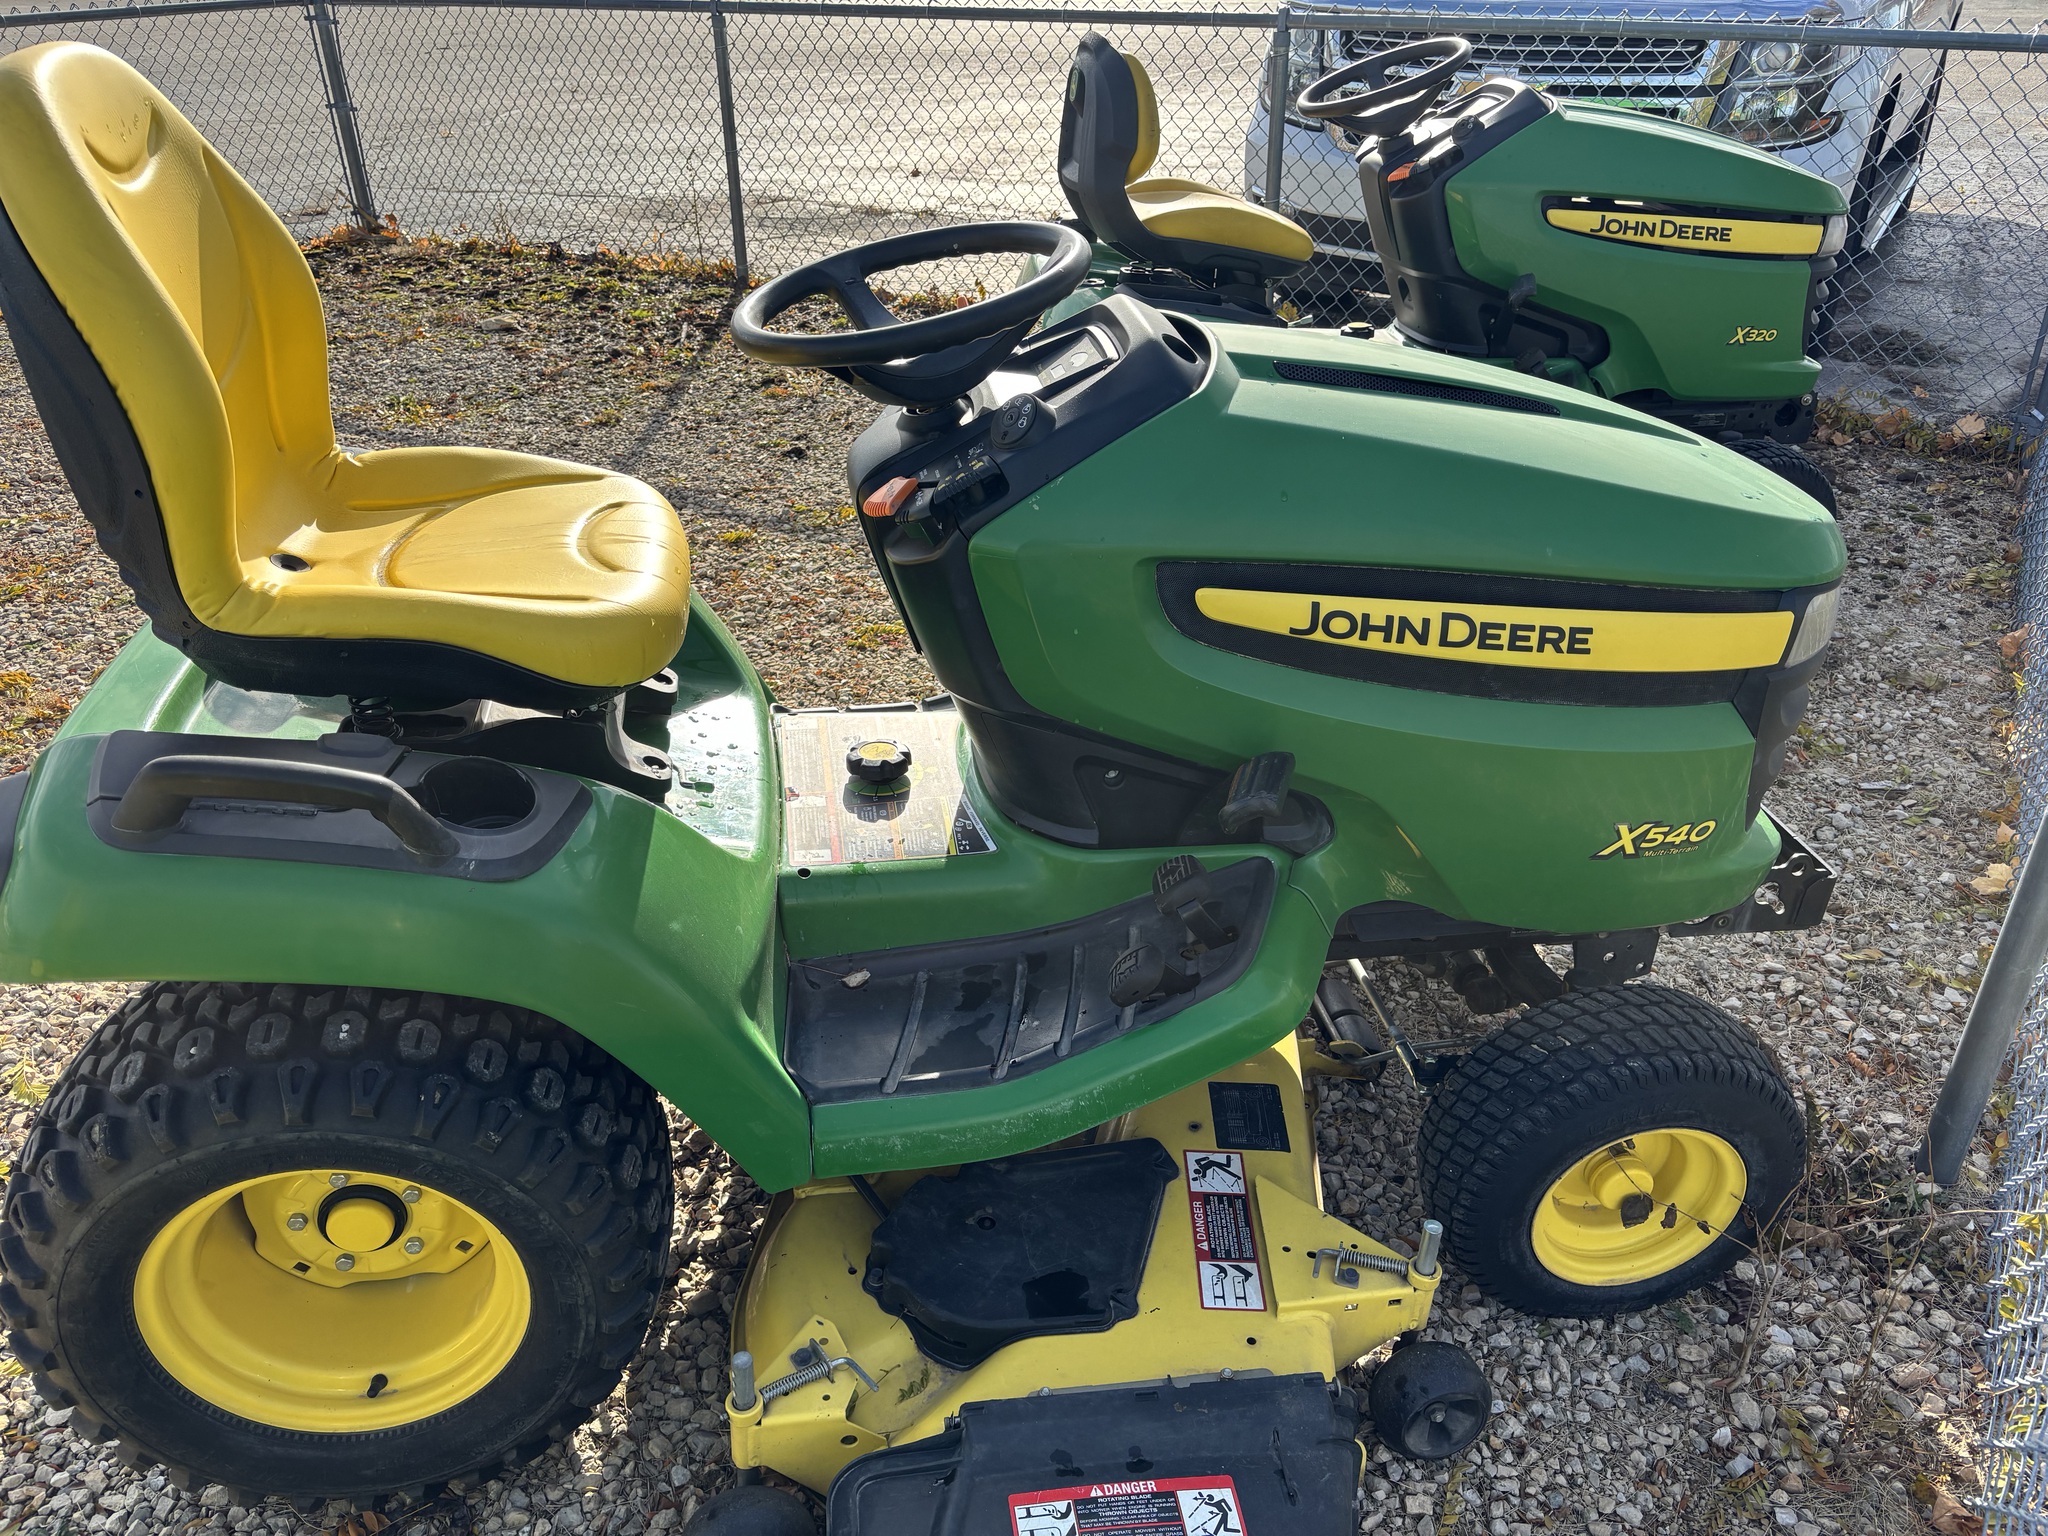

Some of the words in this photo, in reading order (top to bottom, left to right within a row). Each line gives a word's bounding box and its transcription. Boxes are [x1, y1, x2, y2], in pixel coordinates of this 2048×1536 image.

[1590, 214, 1657, 238] JOHN
[1659, 219, 1732, 242] DEERE
[1728, 326, 1778, 345] X320
[1289, 601, 1430, 646] JOHN
[1438, 612, 1593, 655] DEERE
[1592, 819, 1717, 858] X540
[1643, 845, 1699, 857] Multi-Terrain
[1193, 1201, 1206, 1240] DANGER
[1104, 1481, 1156, 1495] DANGER
